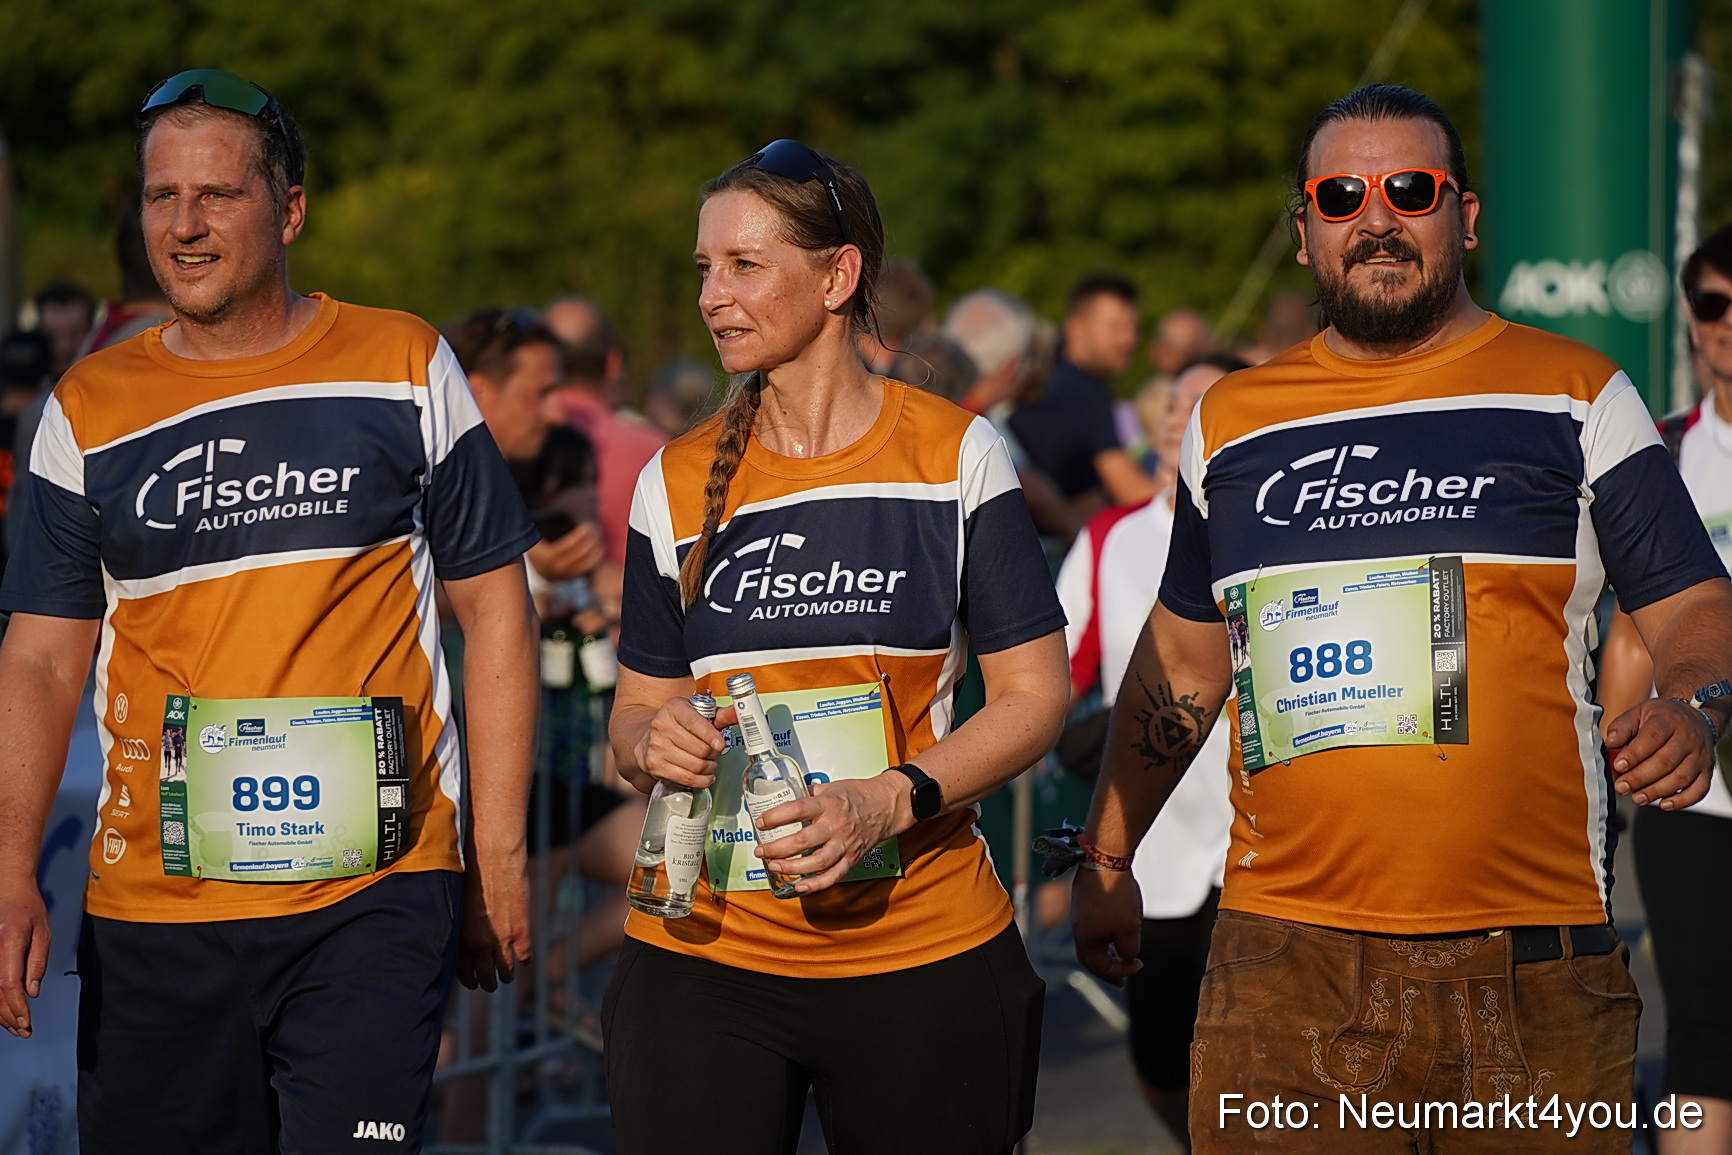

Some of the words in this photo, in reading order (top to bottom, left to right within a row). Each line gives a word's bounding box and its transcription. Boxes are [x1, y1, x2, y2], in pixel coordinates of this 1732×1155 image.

[1499, 259, 1612, 318] AOK
[176, 462, 361, 517] Fischer
[1292, 468, 1496, 515] Fischer
[195, 499, 349, 534] AUTOMOBILE
[1307, 505, 1478, 532] AUTOMOBILE
[734, 561, 907, 602] Fischer
[1432, 569, 1441, 614] RABATT
[1442, 570, 1450, 602] OUTLET
[748, 599, 893, 621] AUTOMOBILE
[1228, 598, 1244, 612] AOK
[1285, 600, 1340, 620] Firmenlauf
[1305, 609, 1339, 622] neumarkt
[1433, 613, 1441, 623] %
[1443, 603, 1451, 638] FACTORY
[1433, 624, 1441, 639] 20
[1289, 639, 1373, 684] 888
[1276, 690, 1337, 714] Christian
[1341, 684, 1404, 700] Mueller
[1440, 676, 1453, 732] HILTL
[166, 709, 186, 721] AOK
[1304, 709, 1321, 717] Fischer
[1321, 705, 1349, 714] Automobile
[374, 708, 385, 749] RABATT
[384, 708, 393, 739] OUTLET
[228, 733, 287, 747] Firmenlauf
[251, 742, 286, 752] neumarkt
[377, 751, 386, 760] %
[386, 740, 395, 775] FACTORY
[115, 762, 134, 774] Audi
[378, 760, 387, 776] 20
[232, 774, 320, 812] 899
[111, 808, 130, 820] SEAT
[236, 822, 277, 836] Timo
[280, 820, 325, 836] Stark
[383, 812, 396, 861] HILTL
[107, 837, 122, 855] FIAT
[231, 861, 289, 872] firmenlauf.bayern
[352, 1120, 406, 1142] JAKO
